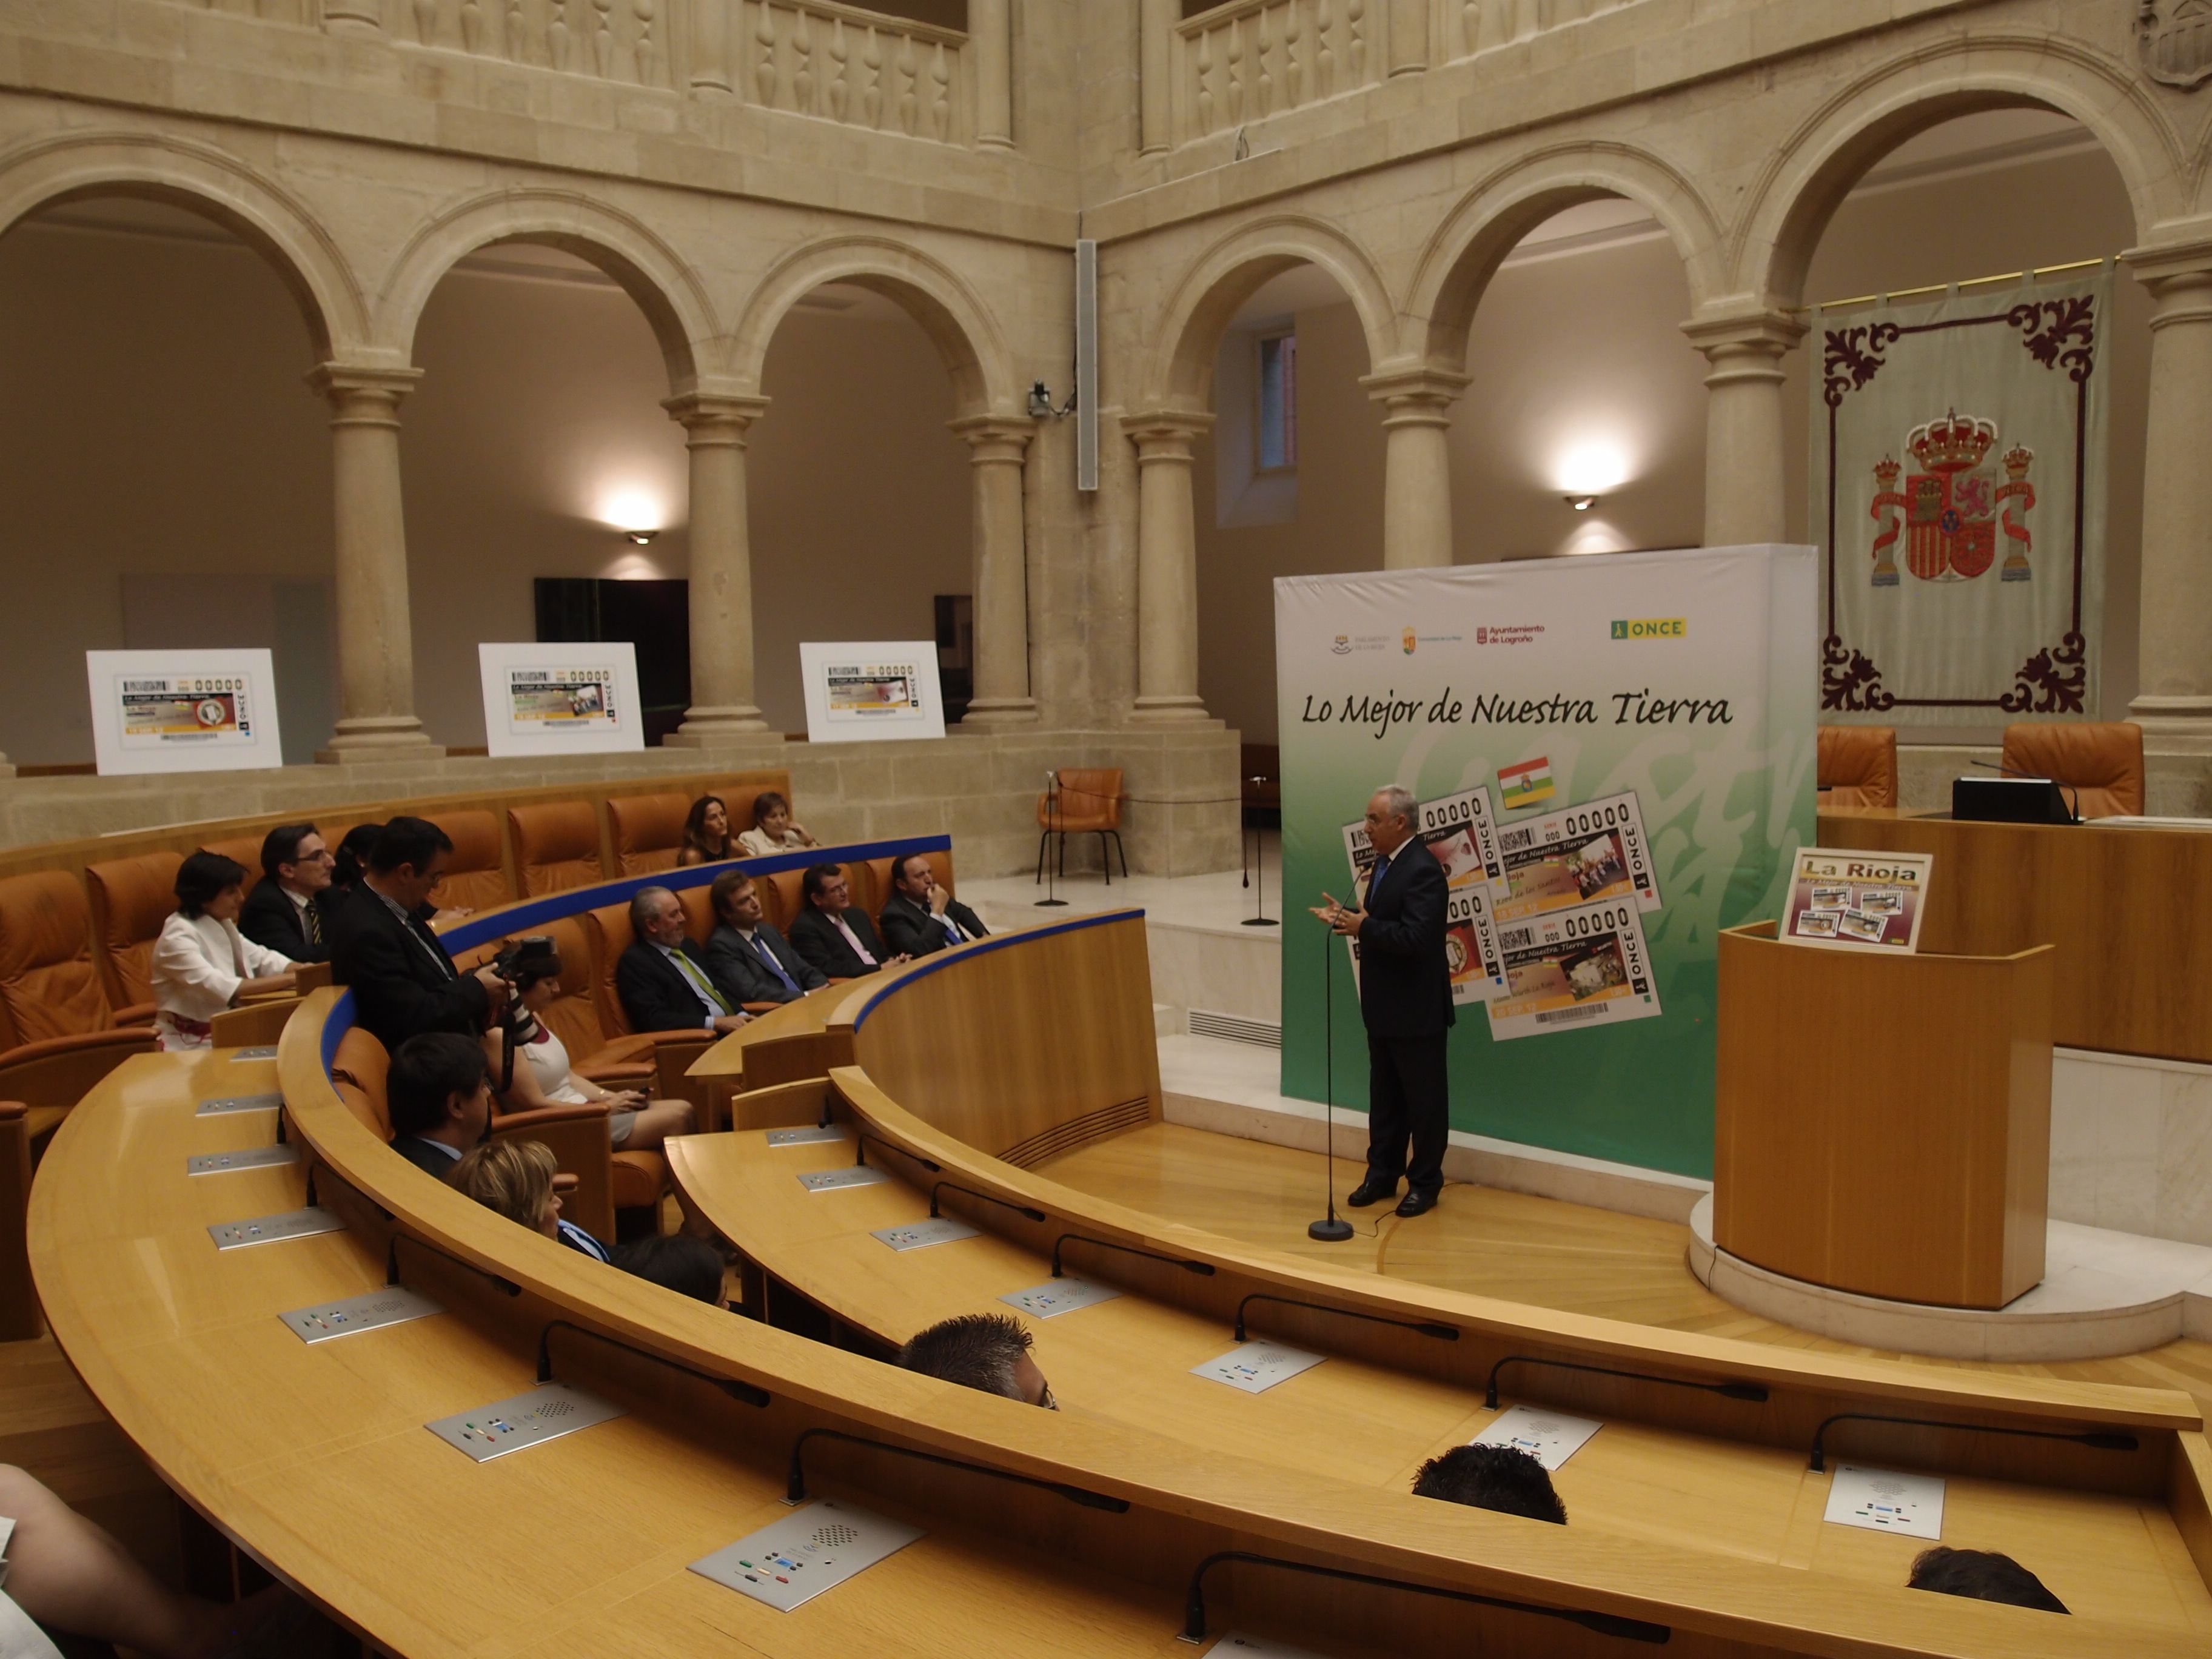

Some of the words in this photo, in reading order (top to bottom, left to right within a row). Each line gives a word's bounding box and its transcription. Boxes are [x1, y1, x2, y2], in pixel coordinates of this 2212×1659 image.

[1490, 625, 1544, 635] Ayuntamiento
[1501, 635, 1533, 645] Logroño
[1632, 622, 1681, 635] ONCE
[571, 671, 609, 682] 00000
[879, 666, 913, 675] 00000
[195, 679, 243, 691] 00000
[237, 694, 246, 720] ONCE
[1302, 694, 1332, 724] Lo
[1339, 689, 1424, 740] Mejor
[1428, 686, 1463, 724] de
[1470, 692, 1598, 725] Nuestra
[1612, 688, 1733, 725] Tierra
[1426, 797, 1481, 828] 00000
[1566, 803, 1629, 836] 00000
[1478, 820, 1493, 860] ONCE
[1546, 831, 1560, 842] 000
[1626, 827, 1642, 870] ONCE
[1504, 855, 1517, 868] ejor
[1518, 852, 1528, 861] de
[1529, 846, 1560, 859] Nuestra
[1563, 837, 1589, 850] Tierra
[1806, 861, 1837, 876] La
[1846, 863, 1916, 883] Rioja
[1449, 895, 1482, 919] 000
[1566, 907, 1629, 937] 00000
[1478, 919, 1493, 959] ONCE
[1545, 933, 1560, 943] 000
[1516, 952, 1526, 961] de
[1529, 947, 1558, 958] Nuestra
[1561, 940, 1587, 952] Tierra
[1624, 932, 1641, 974] ONCE
